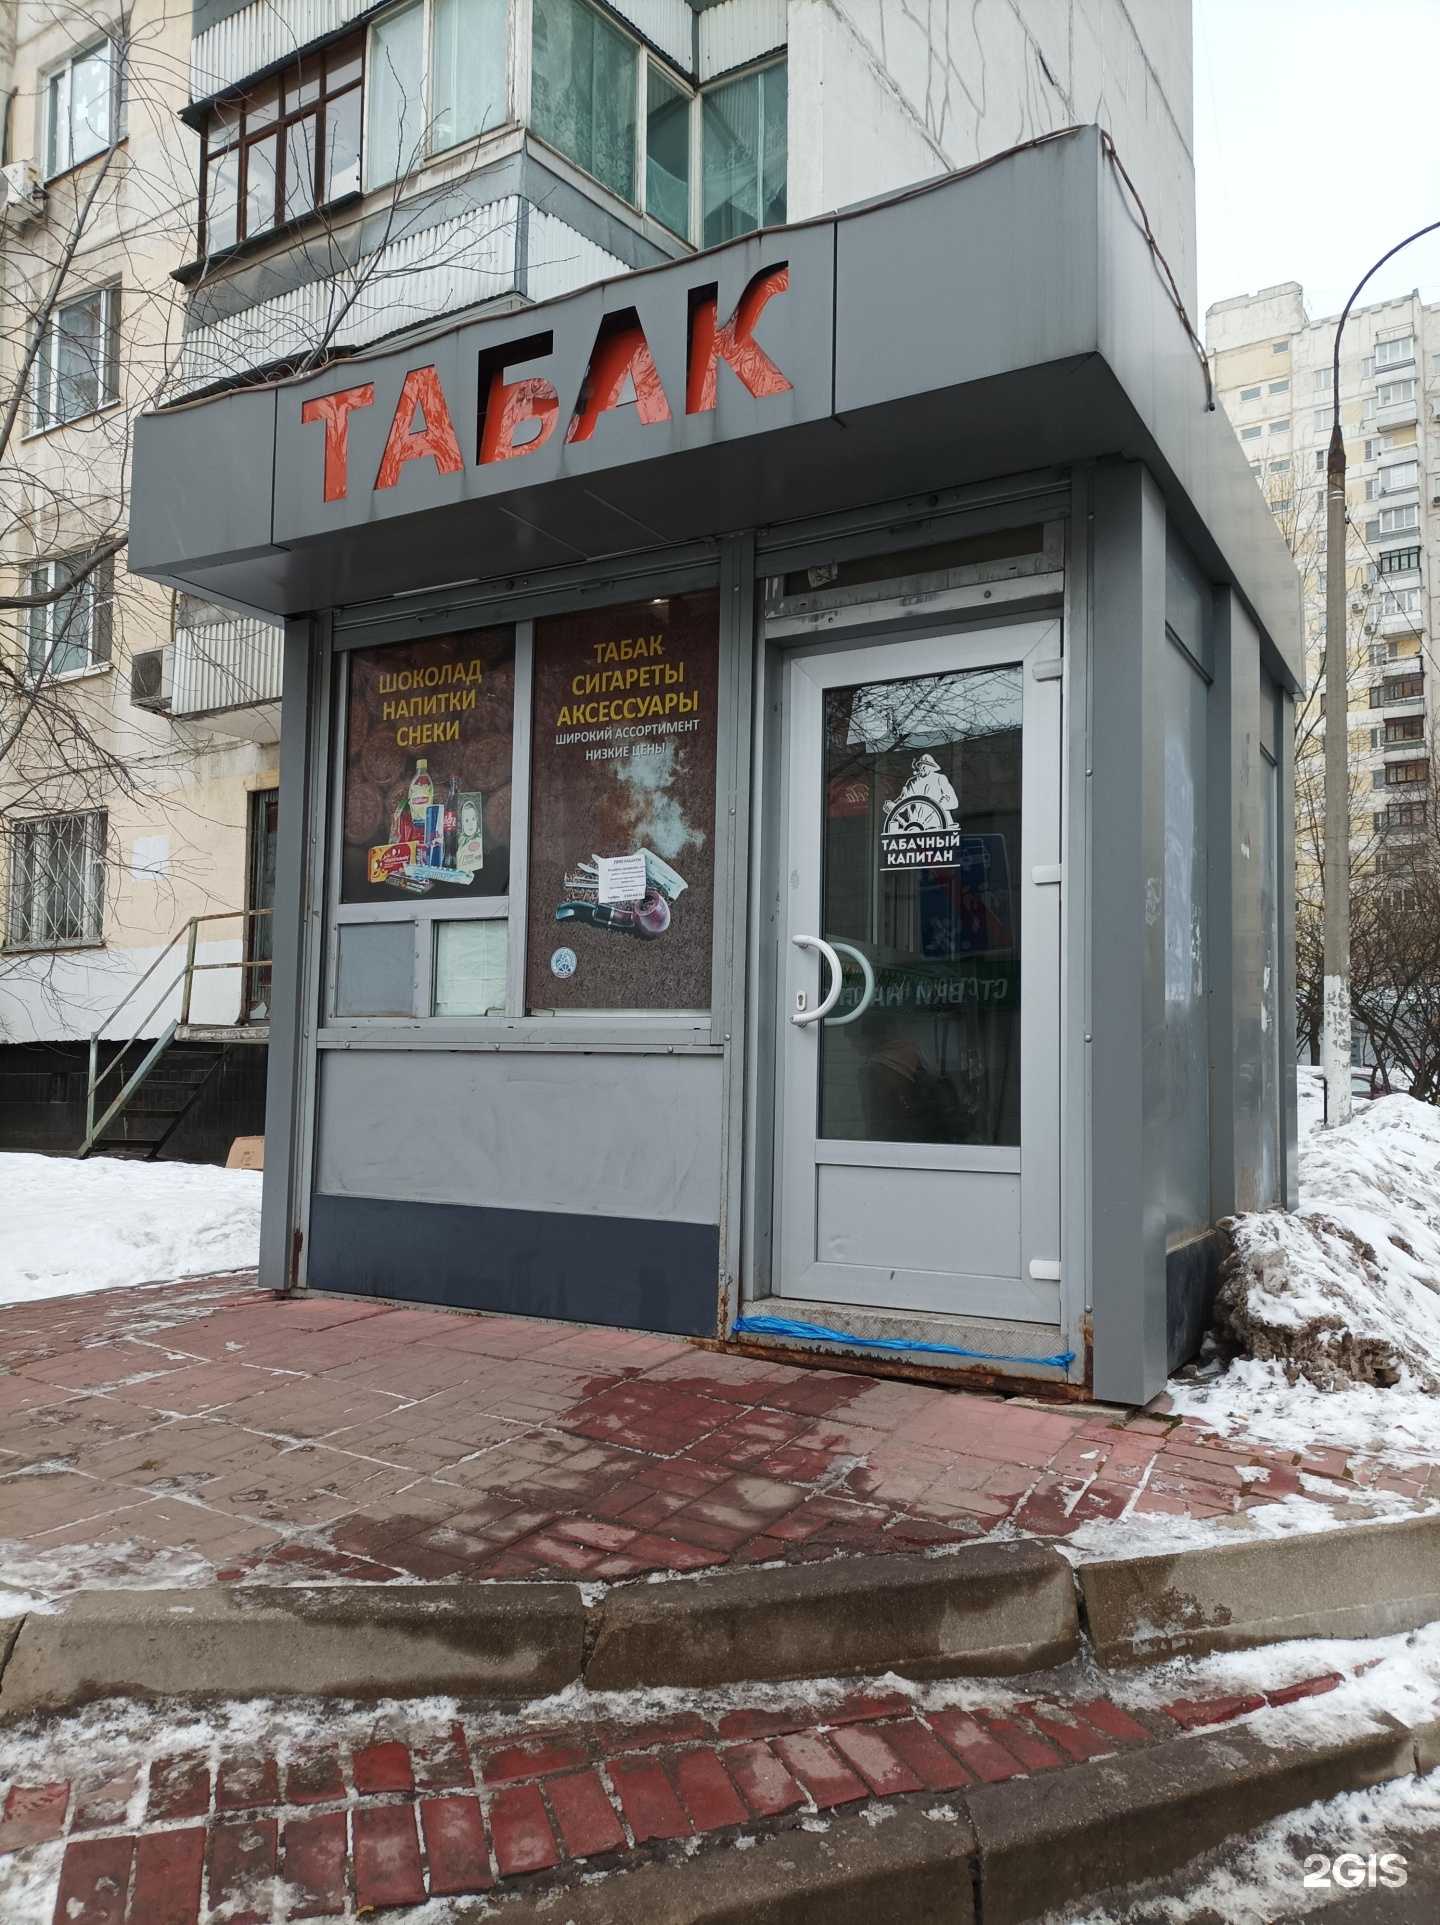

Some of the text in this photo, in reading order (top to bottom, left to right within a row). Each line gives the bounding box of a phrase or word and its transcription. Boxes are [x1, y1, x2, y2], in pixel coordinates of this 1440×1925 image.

[301, 260, 795, 502] ТАБАК
[593, 634, 664, 664] ТАБАК
[378, 659, 483, 694] ШОКОЛАД
[571, 662, 685, 696] СИГАРЕТЫ
[383, 688, 477, 721] НАПИТКИ
[556, 690, 699, 727] АКСЕССУАРЫ
[396, 720, 460, 747] СНЕКИ
[555, 719, 700, 745] ШИРОКИЙ АССОРТИМЕНТ
[585, 743, 666, 761] НИЗКИЕ ЦЕНЫ
[881, 832, 961, 851] ТАБАЧНЫЙ
[887, 850, 953, 865] КАПИТАН
